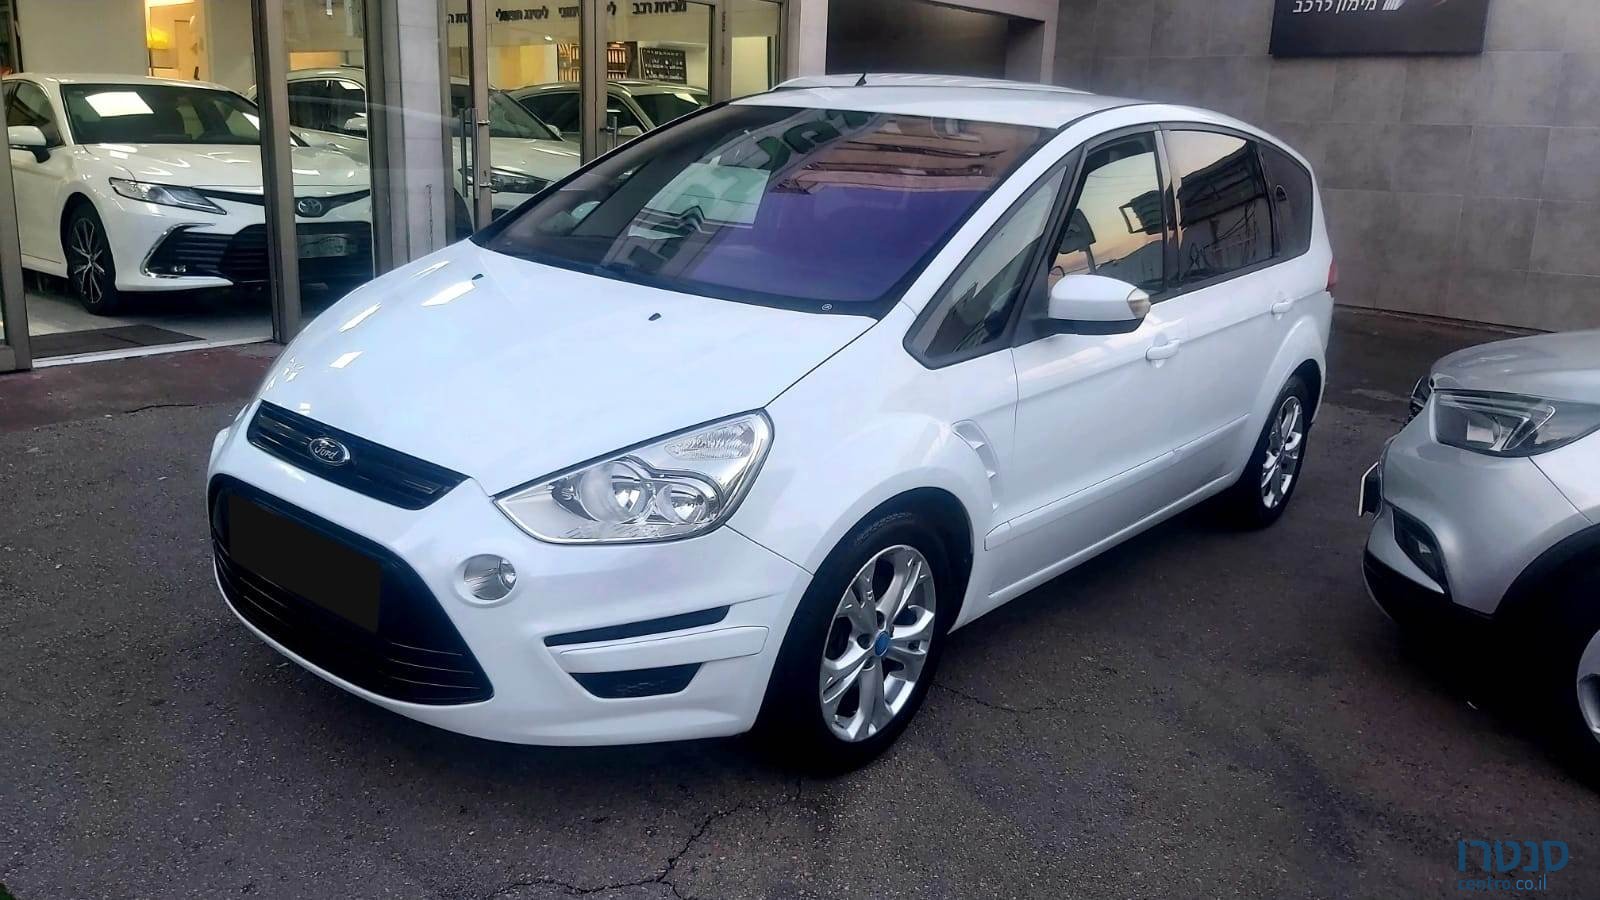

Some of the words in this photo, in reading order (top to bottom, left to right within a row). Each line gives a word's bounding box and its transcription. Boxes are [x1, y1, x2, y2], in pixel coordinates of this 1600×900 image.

[632, 2, 653, 14] רכב
[1335, 0, 1377, 14] מימון
[313, 439, 338, 460] Ford
